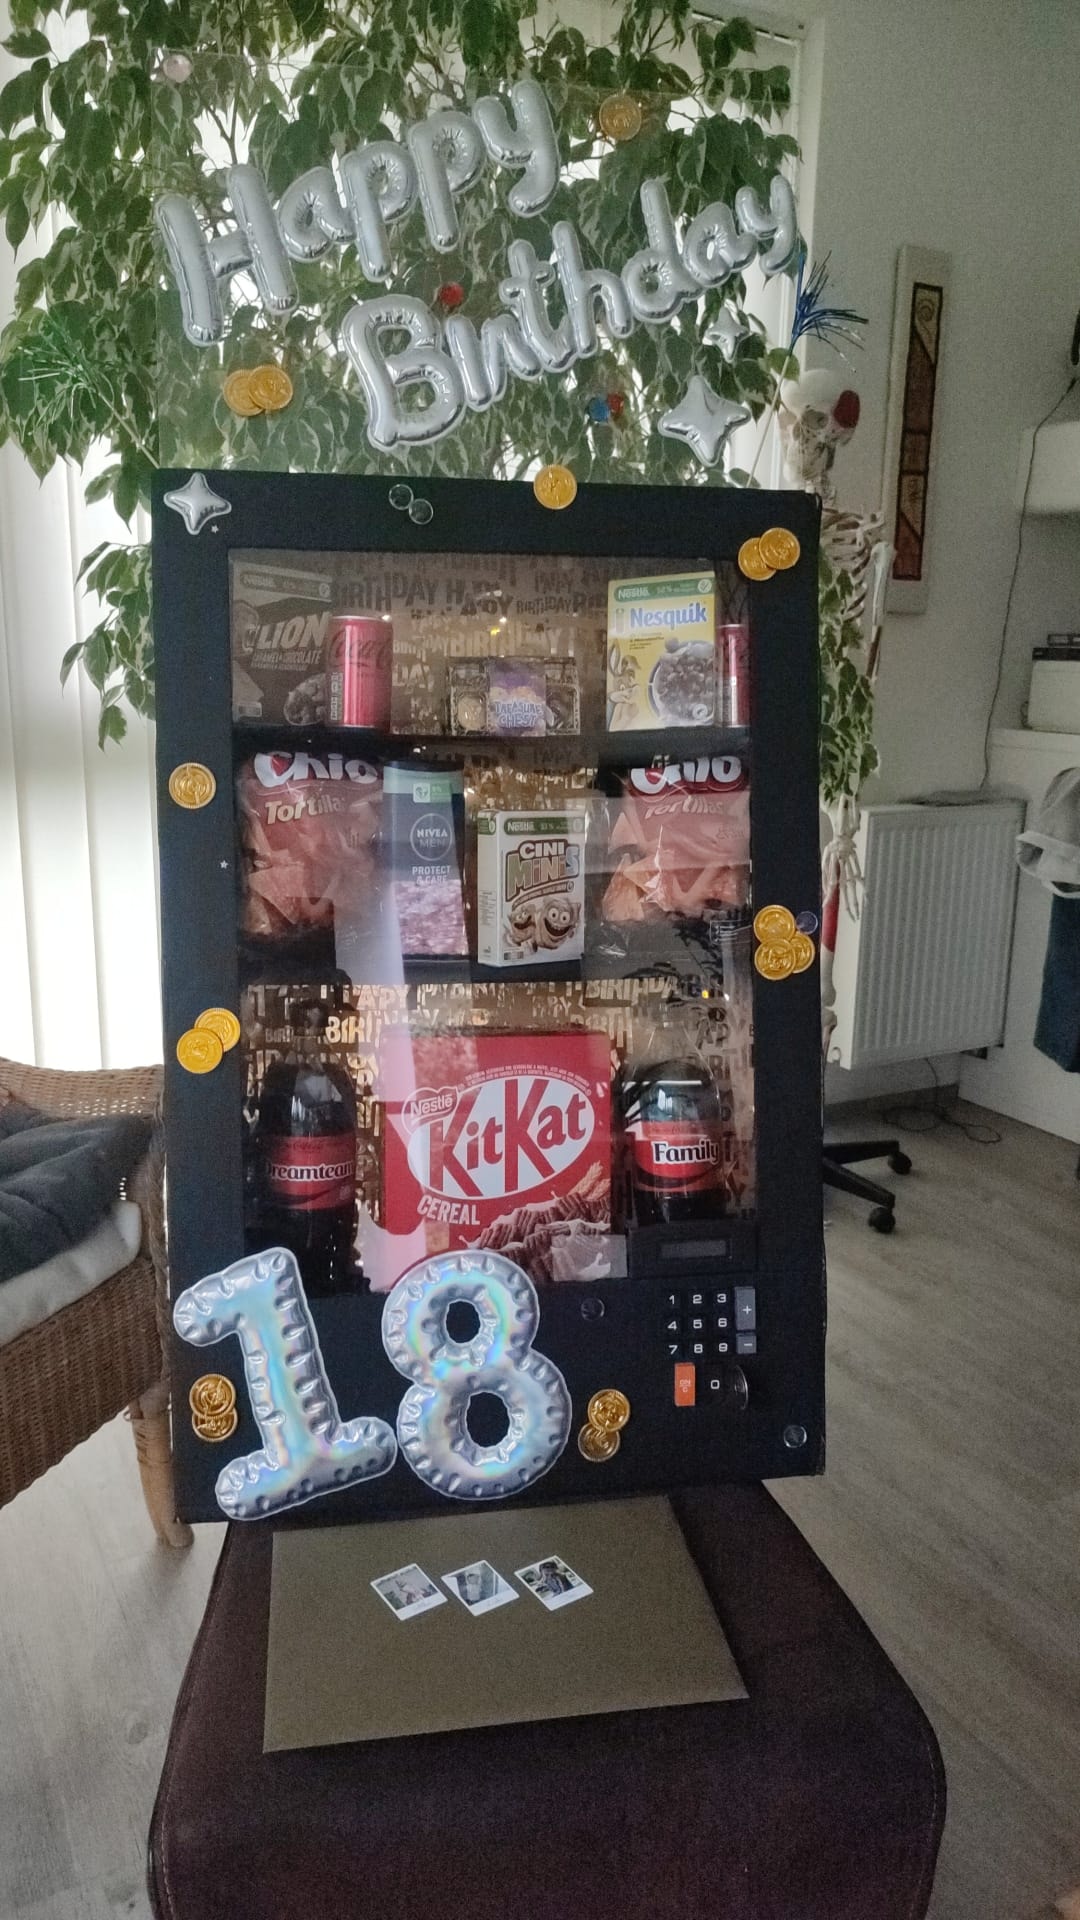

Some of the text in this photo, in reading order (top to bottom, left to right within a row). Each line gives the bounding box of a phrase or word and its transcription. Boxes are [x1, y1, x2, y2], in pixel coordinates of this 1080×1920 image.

[156, 80, 560, 346] Happy
[342, 175, 798, 452] Birthday
[630, 602, 707, 630] Nesquik
[256, 611, 332, 650] LION
[495, 700, 544, 717] TREASURE
[498, 714, 538, 729] CHEST
[254, 751, 378, 788] Chio
[416, 828, 448, 838] NIVEA
[419, 838, 446, 848] MEN
[519, 842, 565, 860] CINI
[412, 865, 451, 876] PROTECT
[424, 875, 447, 885] CARE
[410, 1094, 453, 1117] Nestlé
[429, 1078, 587, 1198] KitKat
[653, 1139, 718, 1164] Family
[418, 1195, 480, 1225] CEREAL
[669, 1293, 726, 1304] 1 2 3
[667, 1318, 727, 1330] 4 5 6
[668, 1342, 728, 1355] 7 8 9
